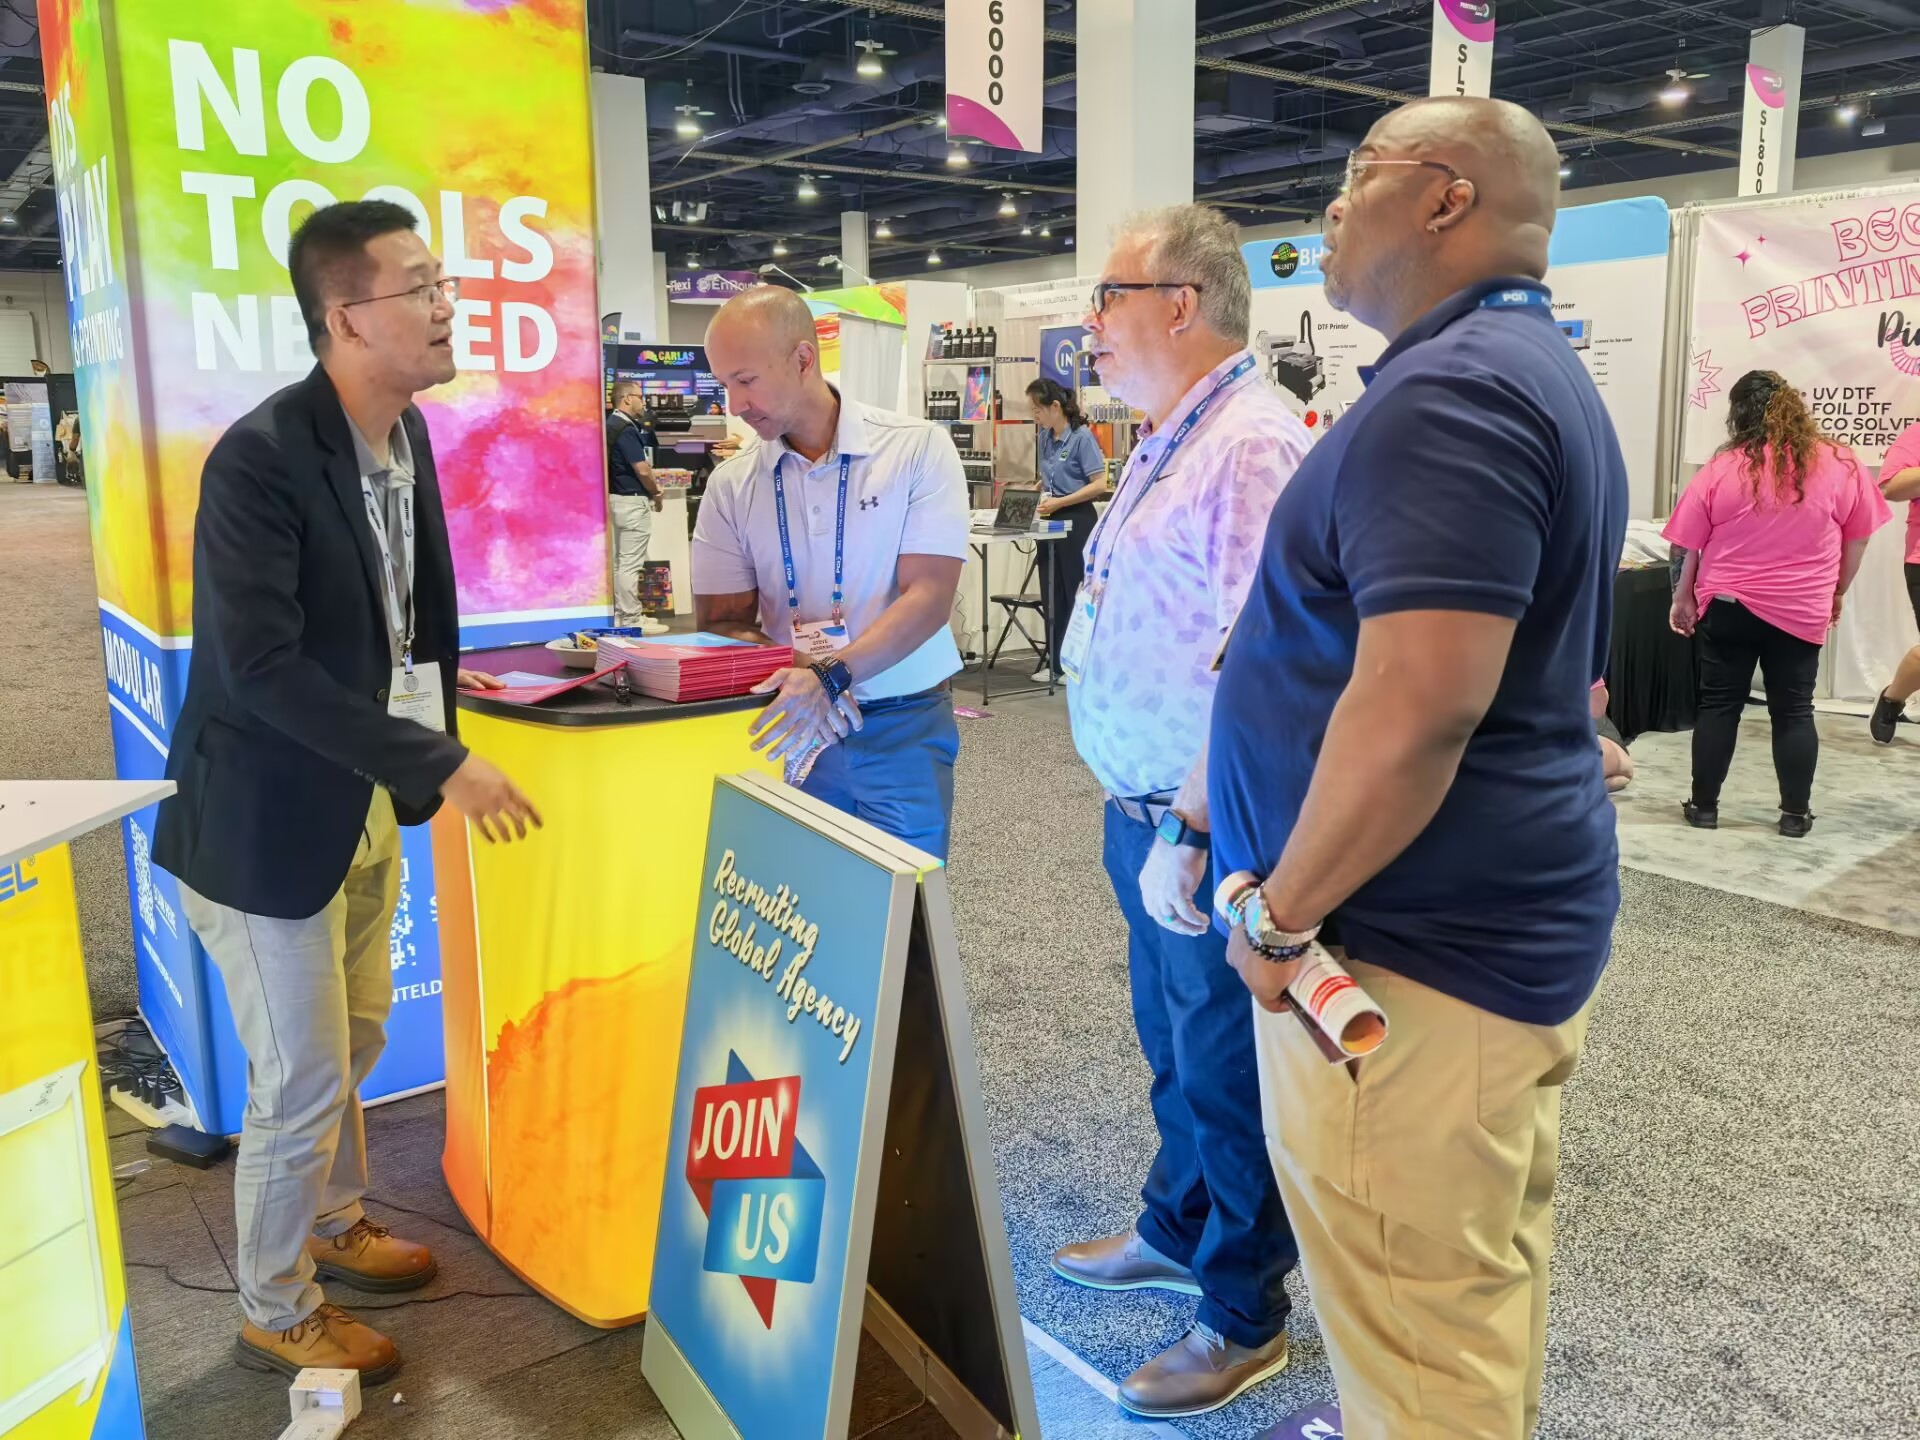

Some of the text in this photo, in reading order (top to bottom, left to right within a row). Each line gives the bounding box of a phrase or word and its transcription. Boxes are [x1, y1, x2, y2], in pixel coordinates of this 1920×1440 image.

[988, 0, 1004, 105] 6000
[51, 82, 76, 184] DIS
[168, 38, 371, 164] NO
[1755, 110, 1767, 194] SL800
[60, 155, 113, 302] PLAY
[191, 291, 558, 372] NEED
[1552, 302, 1575, 310] Printer
[658, 351, 695, 361] CARLAS
[1813, 387, 1876, 401] UV DTF
[1812, 402, 1892, 415] FOIL DTF
[1814, 418, 1920, 431] CO SOLVE
[103, 627, 165, 730] MODULAR
[714, 849, 819, 956] Recruiting
[709, 899, 862, 1064] Global Agency
[695, 1087, 790, 1160] JOIN
[736, 1192, 794, 1274] US
